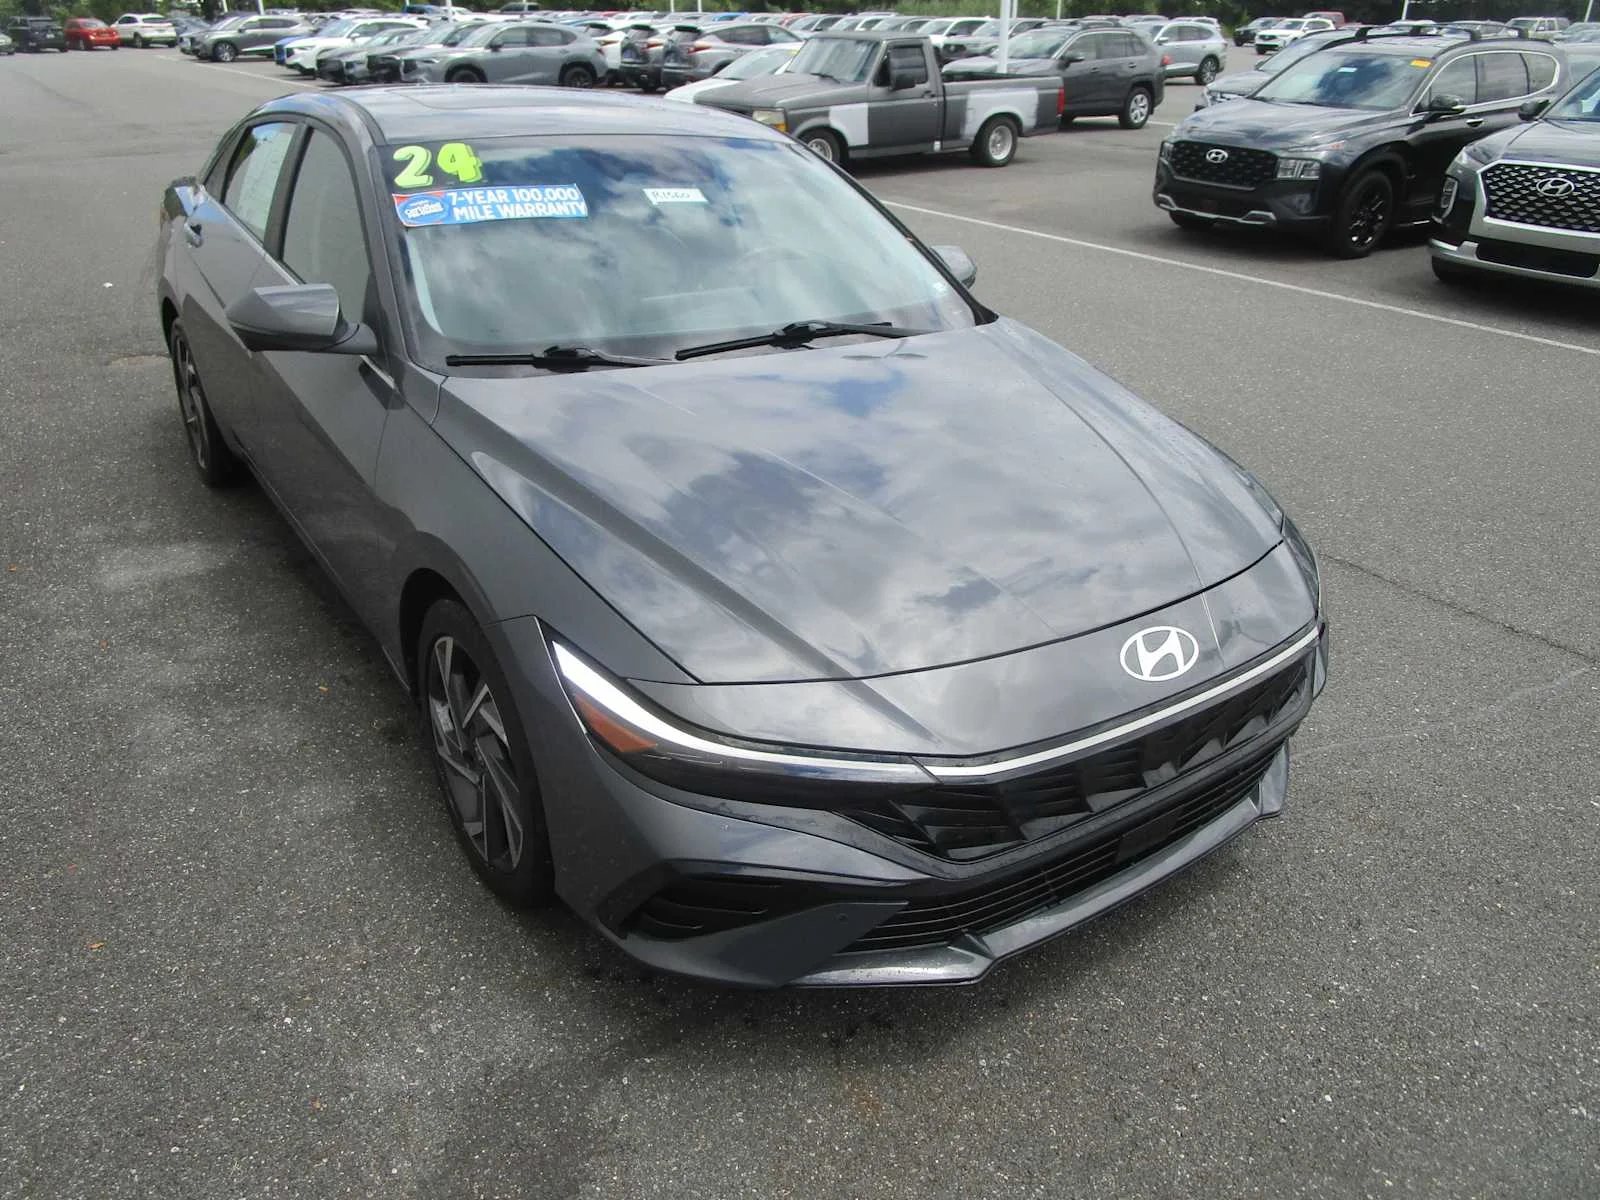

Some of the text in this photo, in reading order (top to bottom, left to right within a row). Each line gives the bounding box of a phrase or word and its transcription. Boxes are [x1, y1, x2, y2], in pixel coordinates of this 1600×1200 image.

[392, 142, 483, 189] 24
[447, 190, 509, 206] 7-YEAR
[511, 187, 579, 203] 100,000
[453, 203, 495, 221] MILE
[495, 201, 587, 218] WARRANTY
